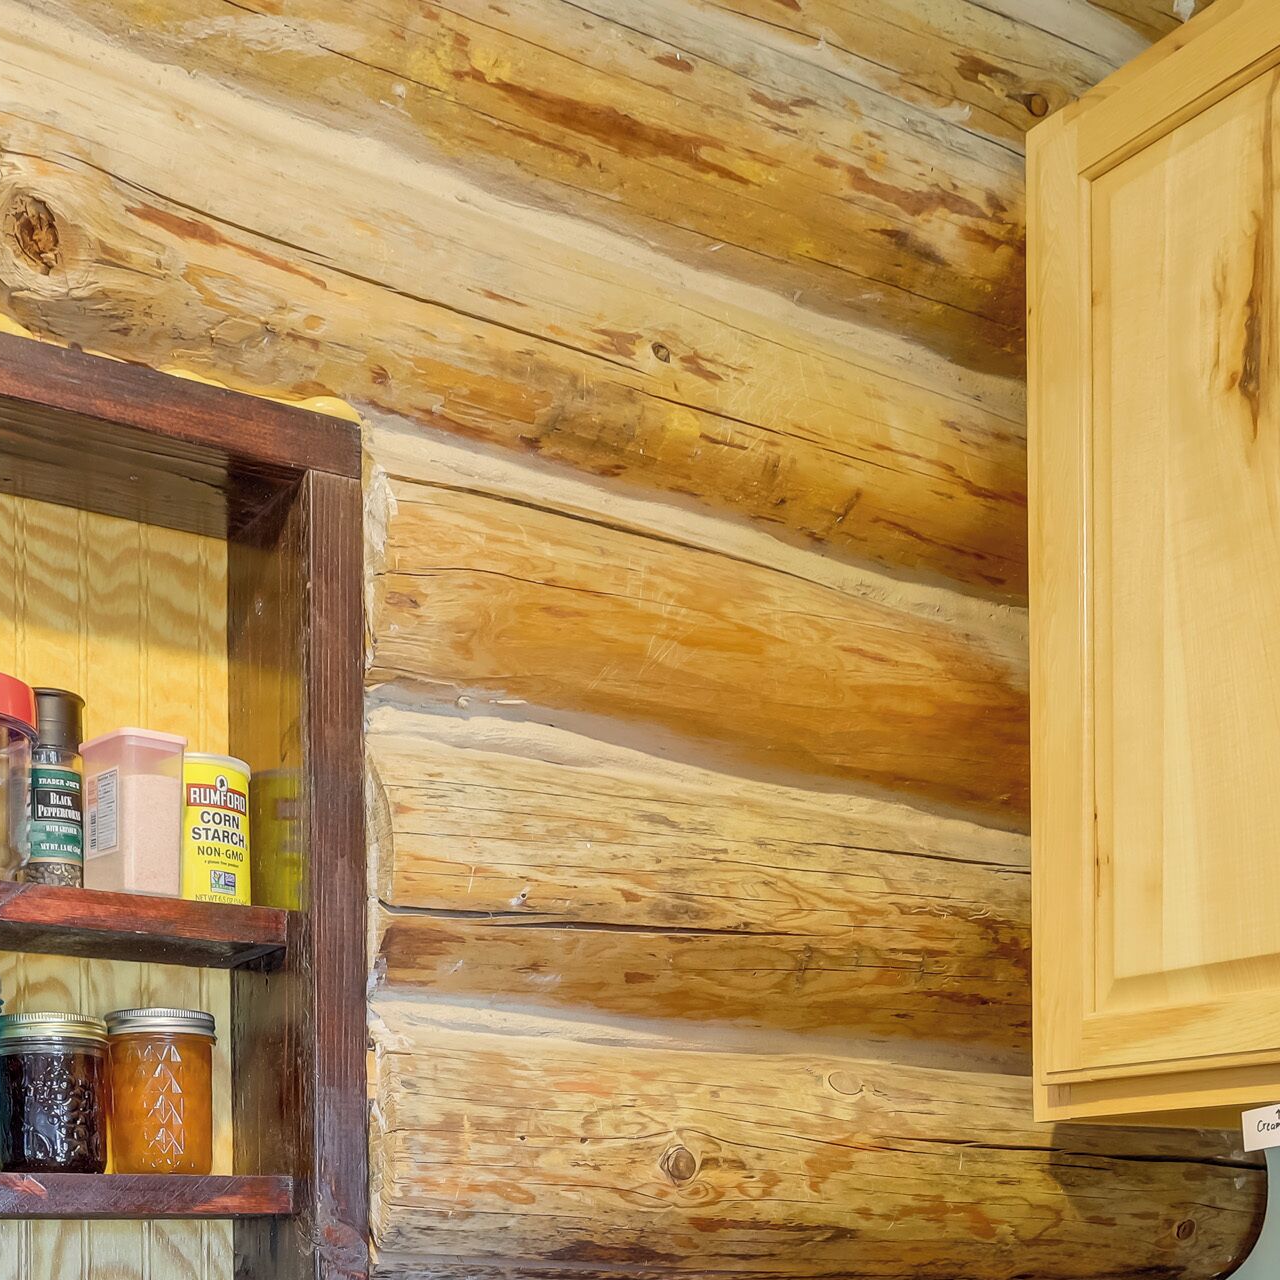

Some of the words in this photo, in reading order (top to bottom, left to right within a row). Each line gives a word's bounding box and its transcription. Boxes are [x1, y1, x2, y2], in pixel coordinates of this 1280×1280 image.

[190, 787, 246, 812] RUMFORD
[201, 810, 239, 829] CORN
[192, 827, 245, 848] STARCH
[197, 846, 243, 862] NON-GMO
